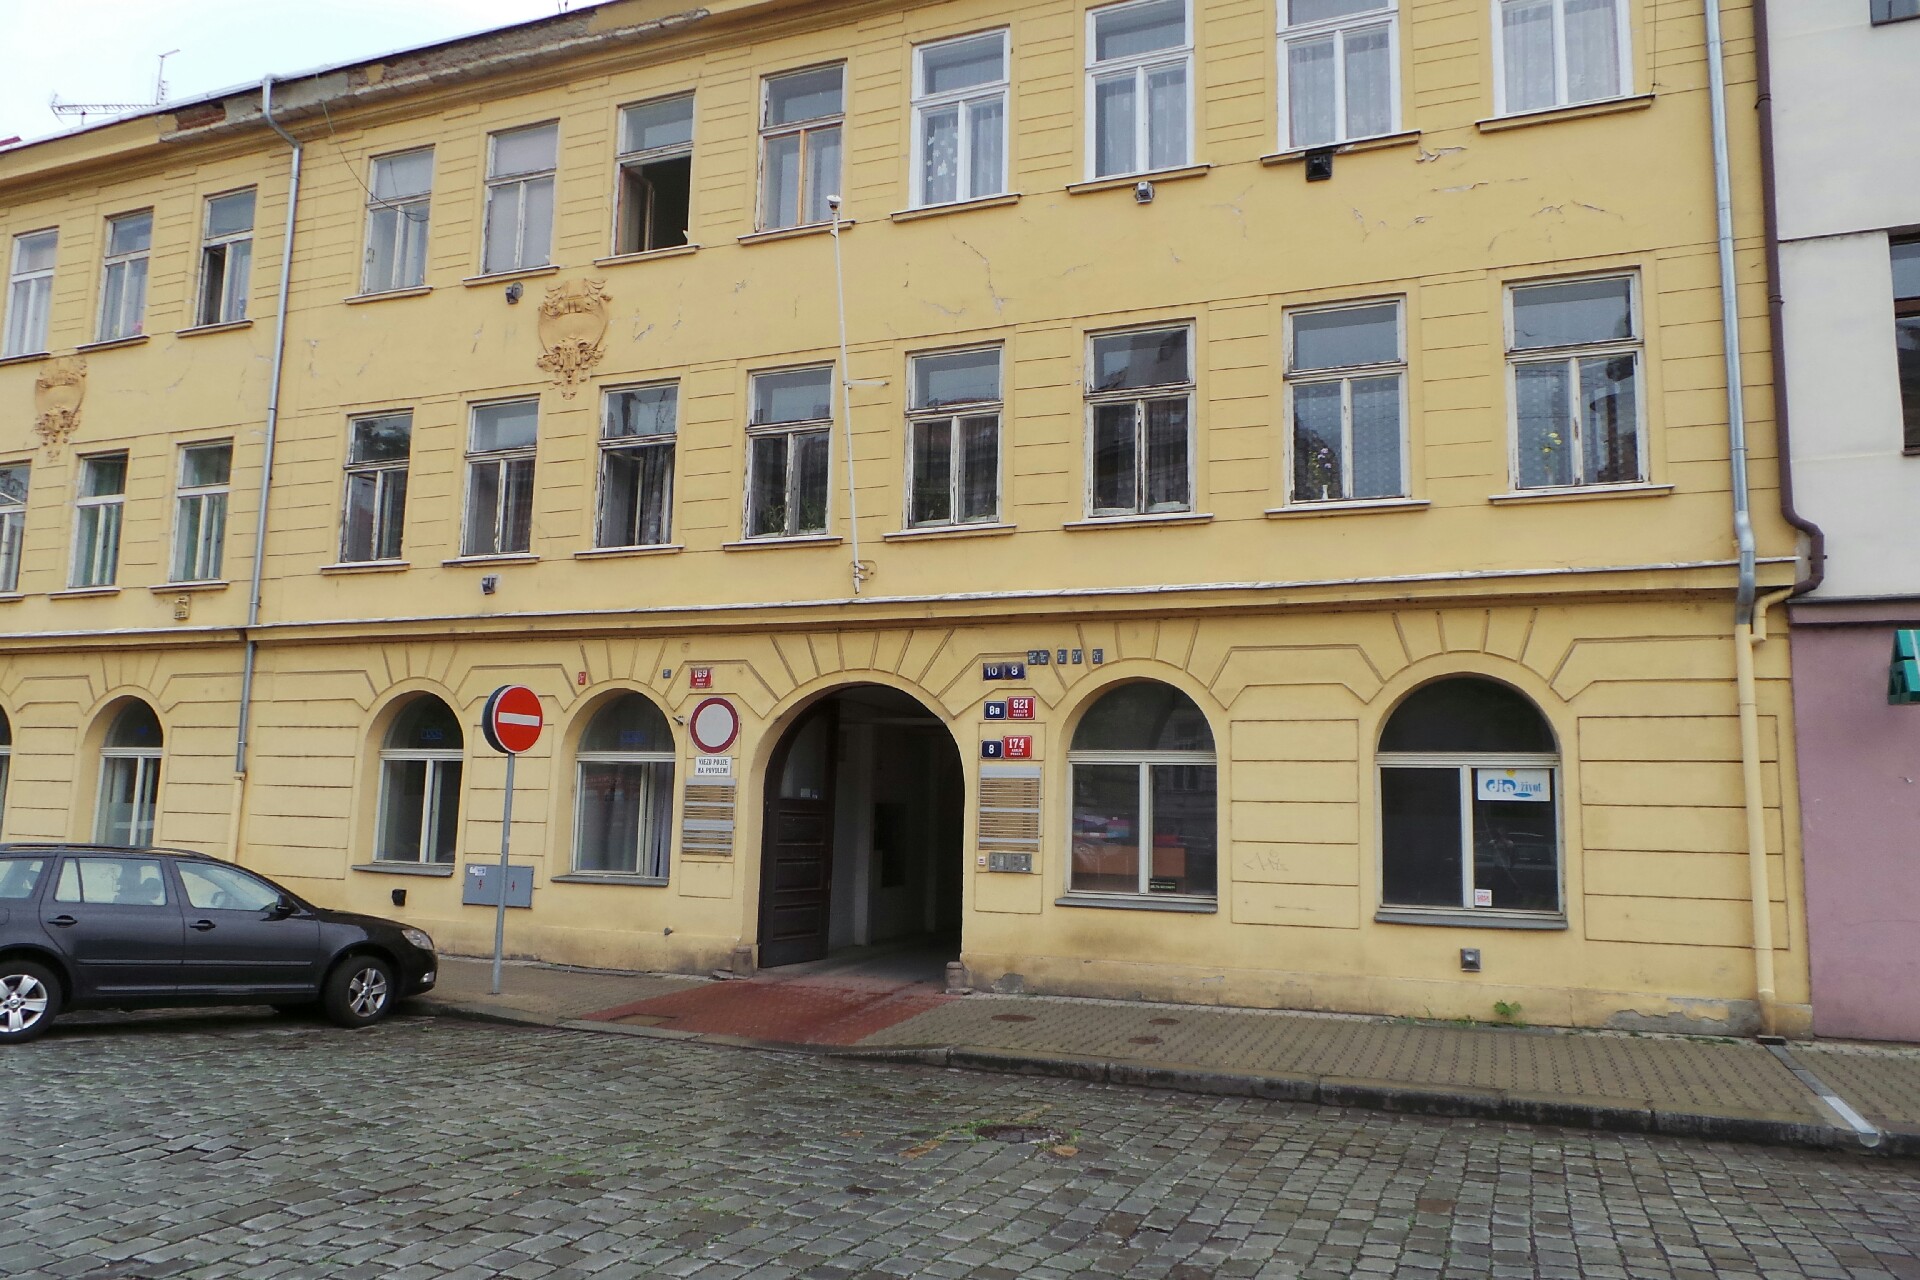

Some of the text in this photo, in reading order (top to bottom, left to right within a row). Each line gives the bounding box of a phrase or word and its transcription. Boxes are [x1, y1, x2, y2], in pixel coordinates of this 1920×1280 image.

[694, 669, 708, 678] 169
[987, 666, 998, 677] 10
[1011, 665, 1018, 676] 8
[1013, 699, 1029, 709] 621
[989, 705, 1000, 716] 8a
[988, 744, 995, 754] 8
[1008, 738, 1025, 749] 174
